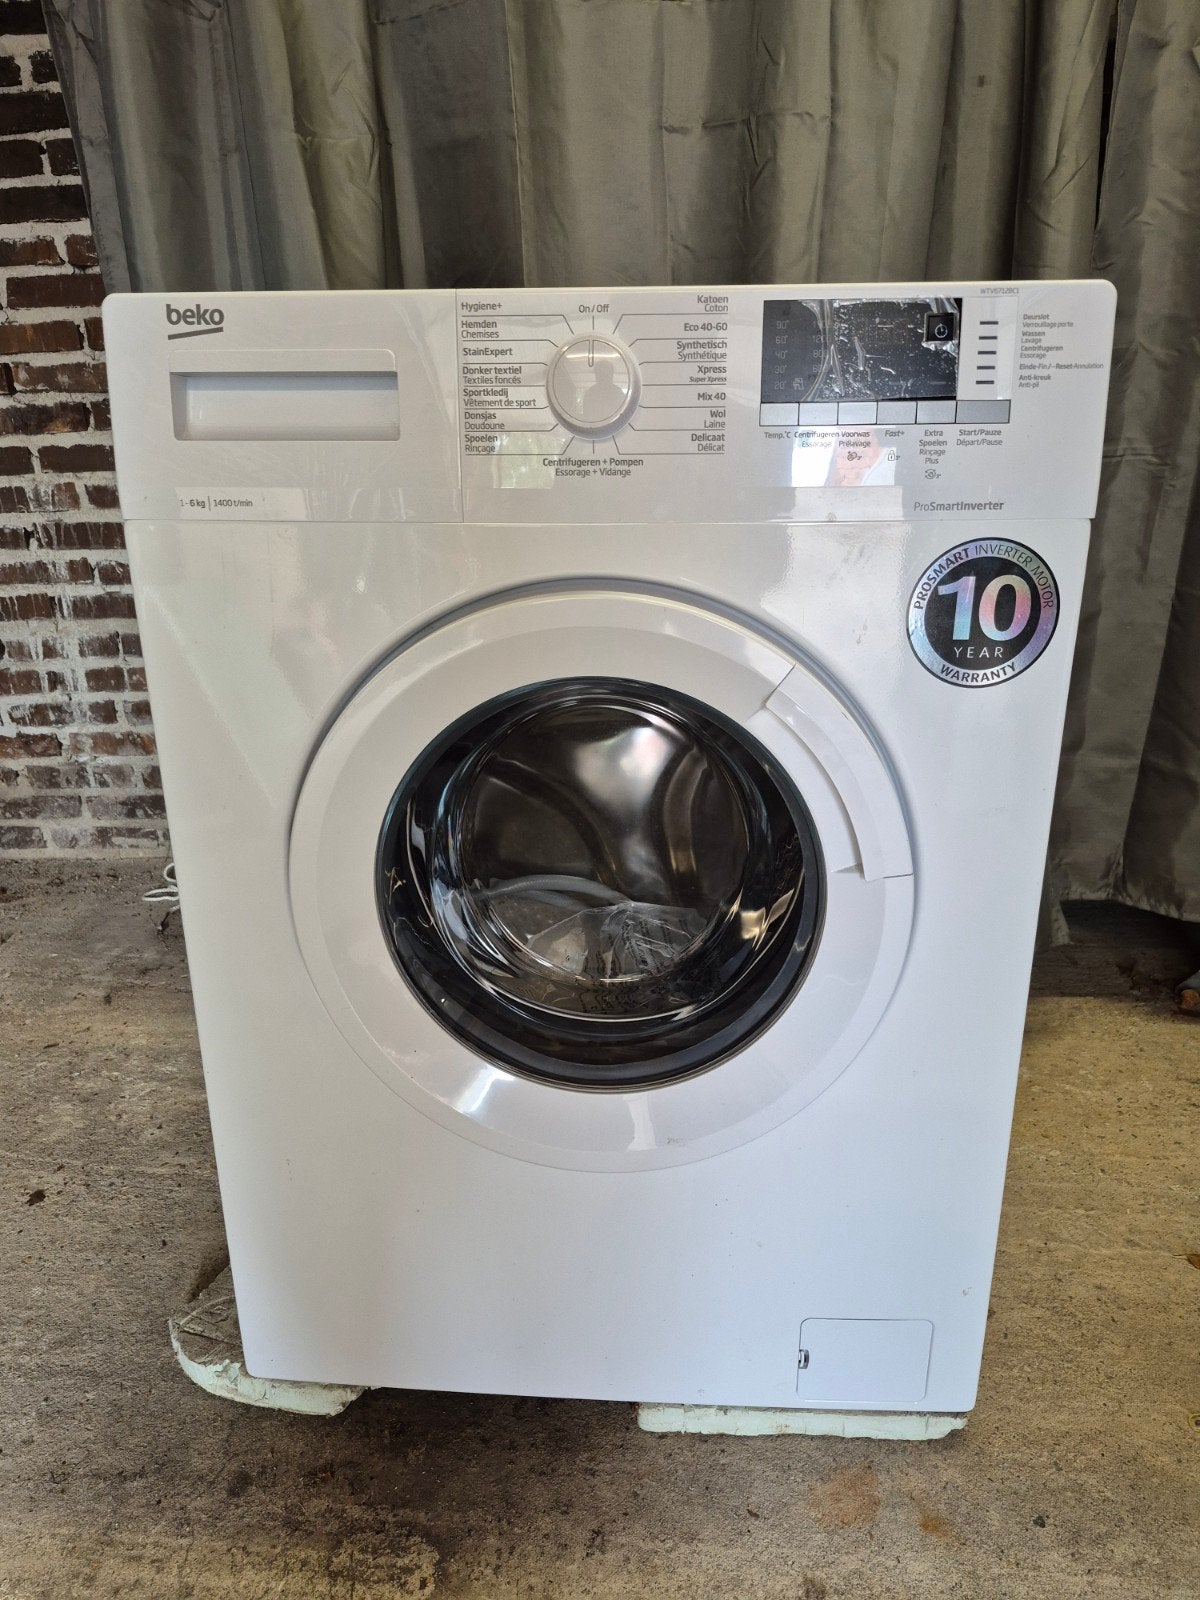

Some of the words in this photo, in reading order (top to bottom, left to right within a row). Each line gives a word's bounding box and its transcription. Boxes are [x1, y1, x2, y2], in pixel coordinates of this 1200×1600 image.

[697, 295, 729, 304] Katoen
[461, 302, 503, 312] Hygiene+
[578, 304, 591, 313] On
[597, 304, 609, 313] Off
[704, 304, 729, 312] Coton
[165, 303, 225, 326] beko
[461, 319, 498, 329] Hemden
[684, 323, 699, 331] Eco
[700, 322, 728, 331] 40-60
[1022, 321, 1057, 329] Verrouillage
[461, 329, 500, 339] Chemises
[676, 340, 728, 351] Synthetisch
[1020, 345, 1064, 353] Centrifugeren
[463, 347, 513, 357] StainExpert
[678, 350, 727, 361] Synthétique
[462, 366, 492, 375] Donker
[493, 366, 522, 375] textiel
[697, 365, 727, 375] Xpress
[463, 376, 494, 385] Textiles
[495, 376, 522, 384] foncés
[1018, 373, 1052, 381] Anti-kreuk
[463, 388, 509, 399] Sportkledij
[697, 392, 713, 401] Mix
[714, 392, 726, 401] 40
[463, 398, 503, 408] Vêtement
[504, 398, 514, 407] de
[515, 399, 537, 409] sport
[464, 411, 497, 421] Donsjas
[710, 410, 726, 418] Wol
[464, 422, 506, 430] Doudoune
[704, 420, 726, 429] Laine
[691, 433, 726, 442] Delicaat
[794, 430, 840, 439] Centrifugeren
[884, 429, 905, 437] Fast+
[924, 429, 944, 437] Extra
[464, 433, 499, 444] Spoelen
[956, 439, 1003, 447] Départ/Pause
[697, 443, 726, 452] Délicat
[838, 440, 872, 449] Prélavage
[919, 439, 948, 448] Spoelen
[465, 444, 496, 453] Rinçage
[919, 448, 946, 457] Rinçage
[542, 457, 601, 468] Centrifugeren
[609, 458, 644, 468] Pompen
[924, 457, 939, 465] Plus
[555, 467, 591, 478] Essorage
[600, 468, 632, 478] Vidange
[196, 499, 206, 509] kg
[213, 499, 233, 507] 1400
[233, 498, 253, 507] t/min
[913, 501, 1005, 512] ProSmartInverter
[913, 547, 970, 611] PROSMART
[974, 544, 1033, 568] INVERTER
[1030, 565, 1055, 609] MOTOR
[937, 574, 1032, 642] 10
[953, 646, 1004, 659] YEAR
[939, 661, 1017, 683] WARRANTY
